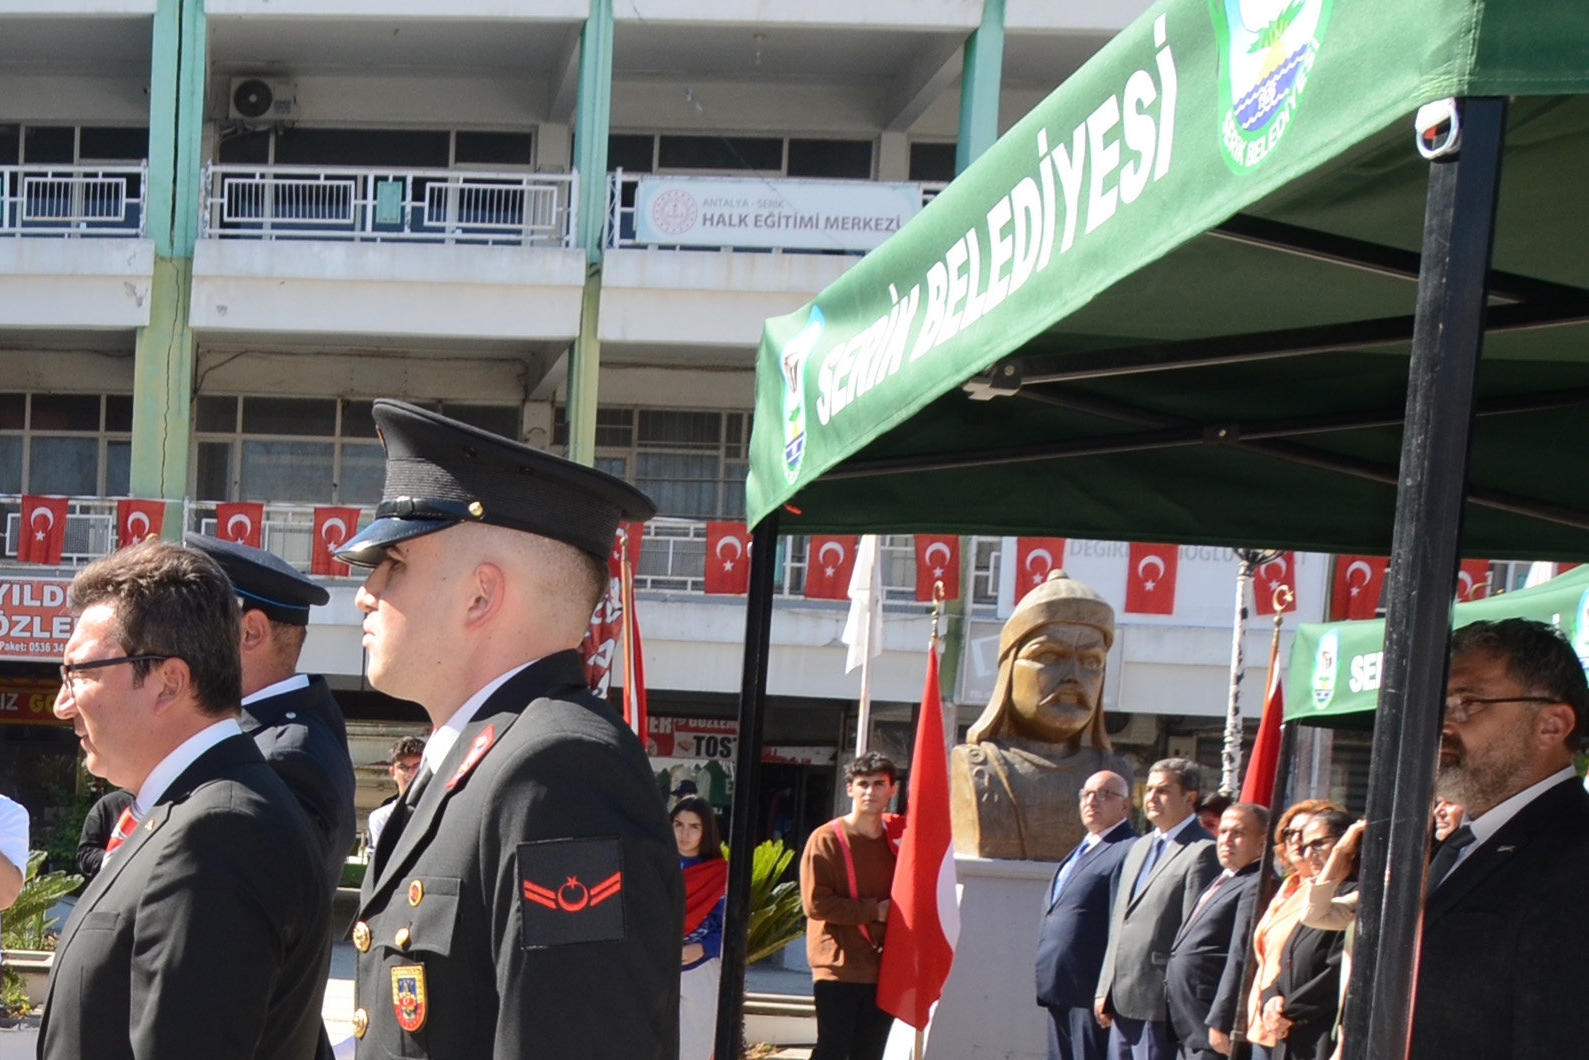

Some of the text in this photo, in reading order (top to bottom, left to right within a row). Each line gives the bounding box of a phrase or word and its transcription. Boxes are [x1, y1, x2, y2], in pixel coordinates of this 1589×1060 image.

[703, 199, 749, 208] ANTALYA
[702, 210, 902, 232] HALK EĞİTİMİ MERKEZİ
[817, 13, 1178, 425] SERİK BELEDİYESİ
[0, 641, 27, 652] Paket:
[29, 642, 51, 653] 0536
[694, 735, 737, 758] TOS
